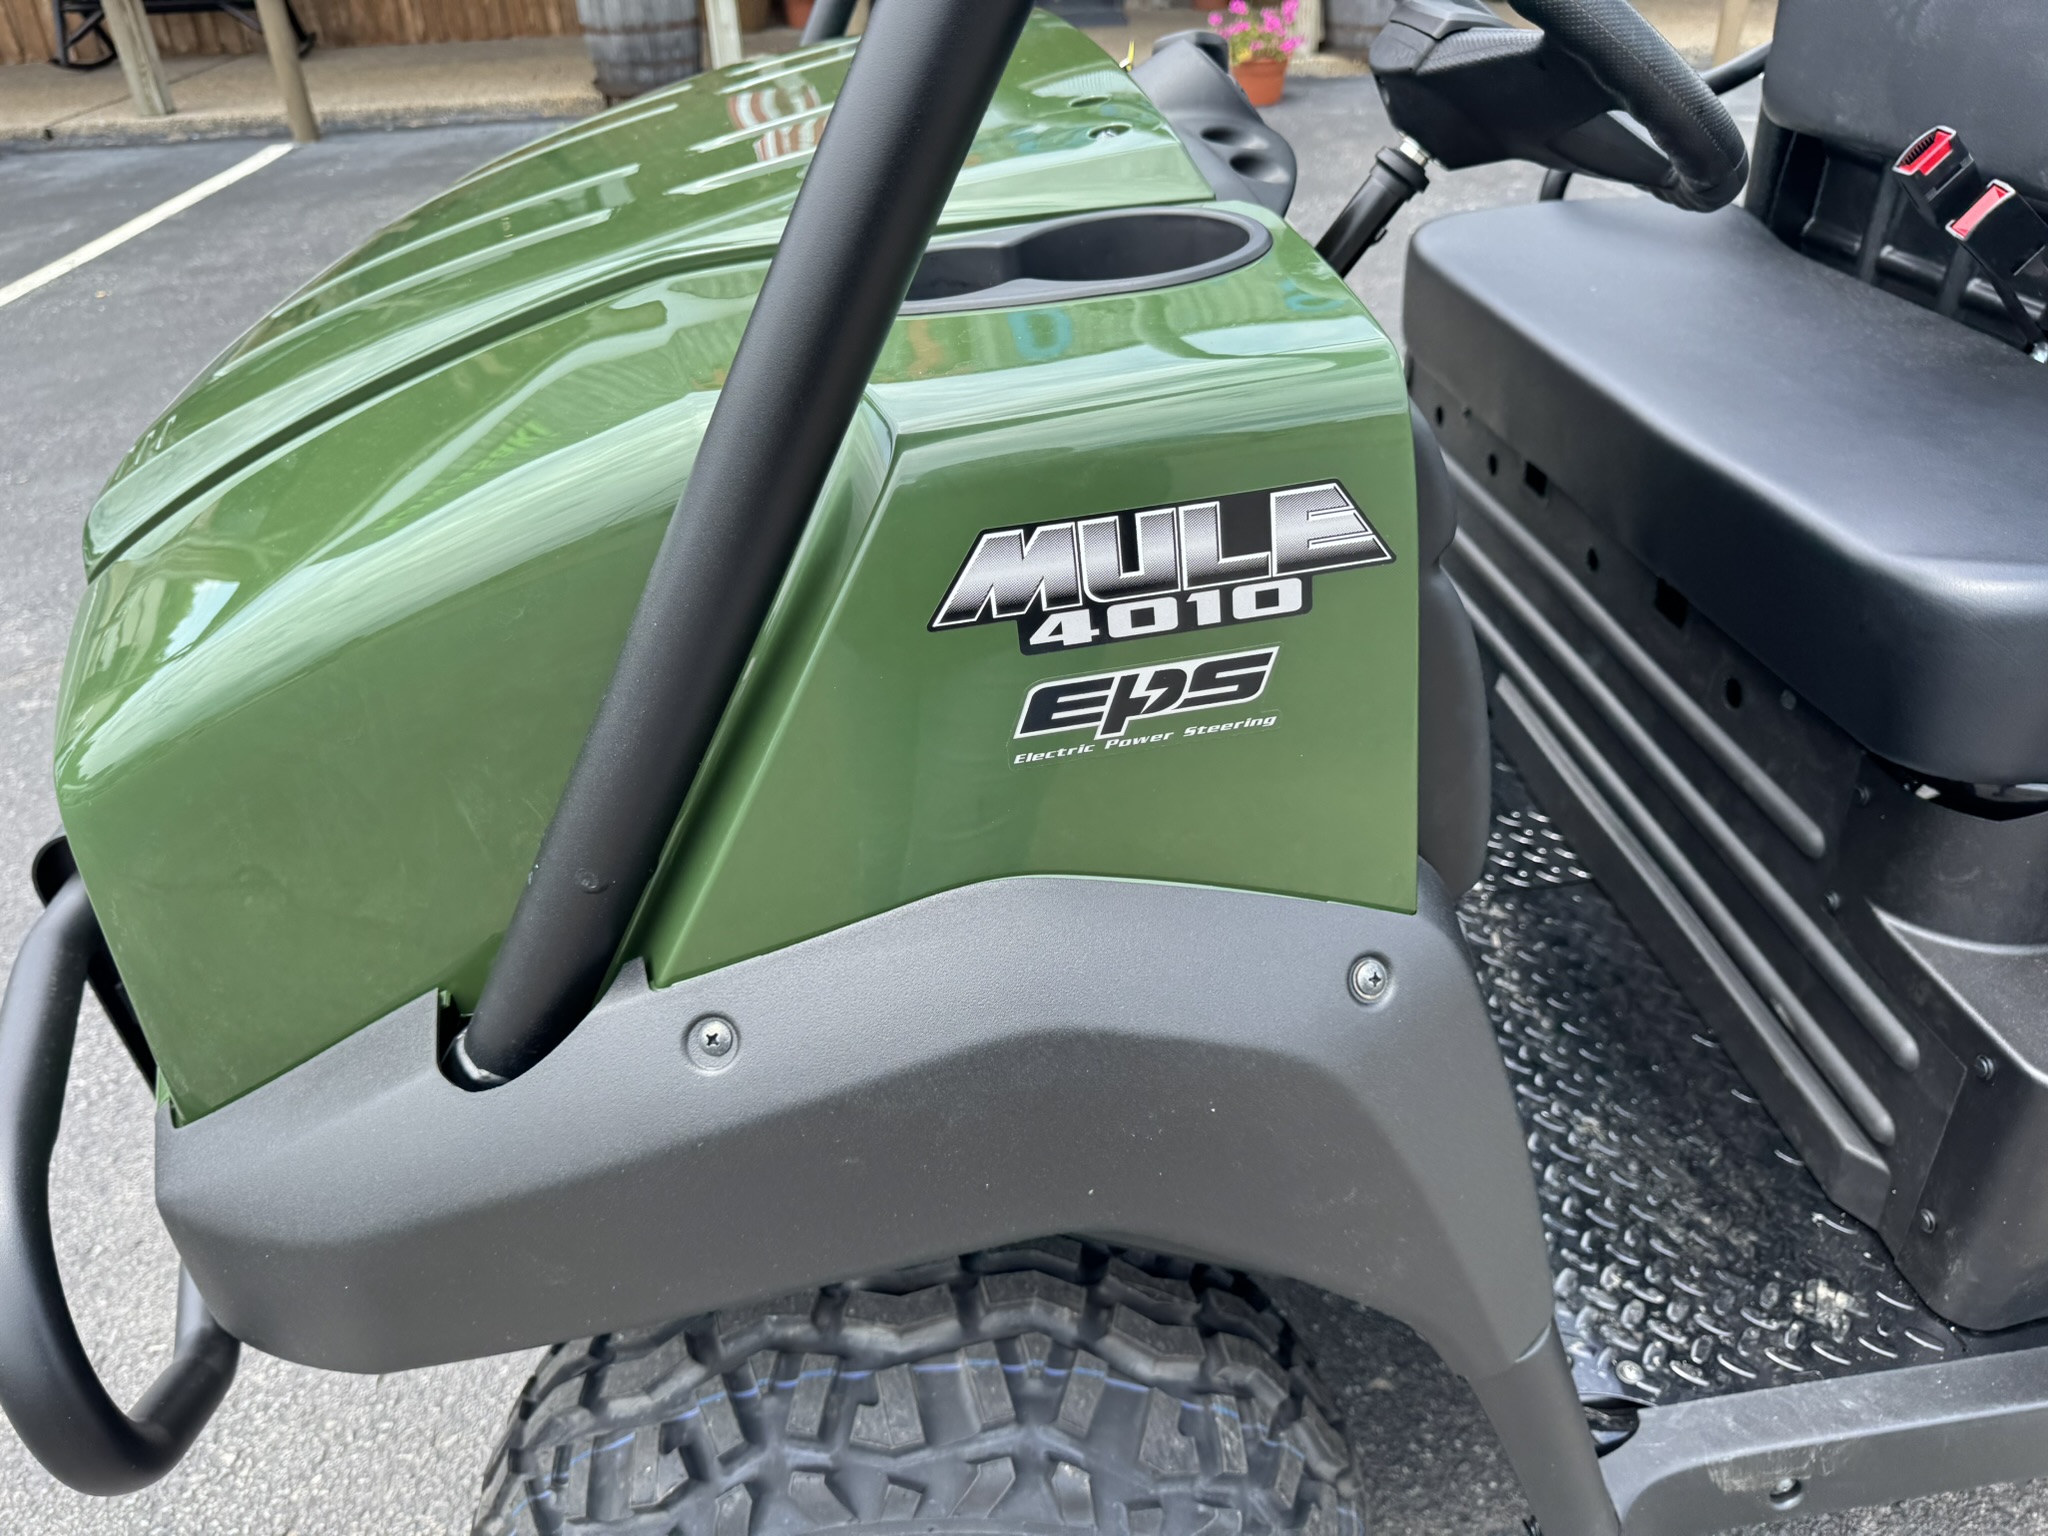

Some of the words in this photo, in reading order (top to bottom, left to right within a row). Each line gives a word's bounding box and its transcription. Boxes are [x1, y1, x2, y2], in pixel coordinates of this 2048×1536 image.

[932, 482, 1392, 628] MULE
[1029, 577, 1303, 646] 4010
[1013, 646, 1280, 740] EPS
[1014, 744, 1095, 765] Electric
[1104, 731, 1174, 750] Power
[1184, 714, 1278, 737] Steering
